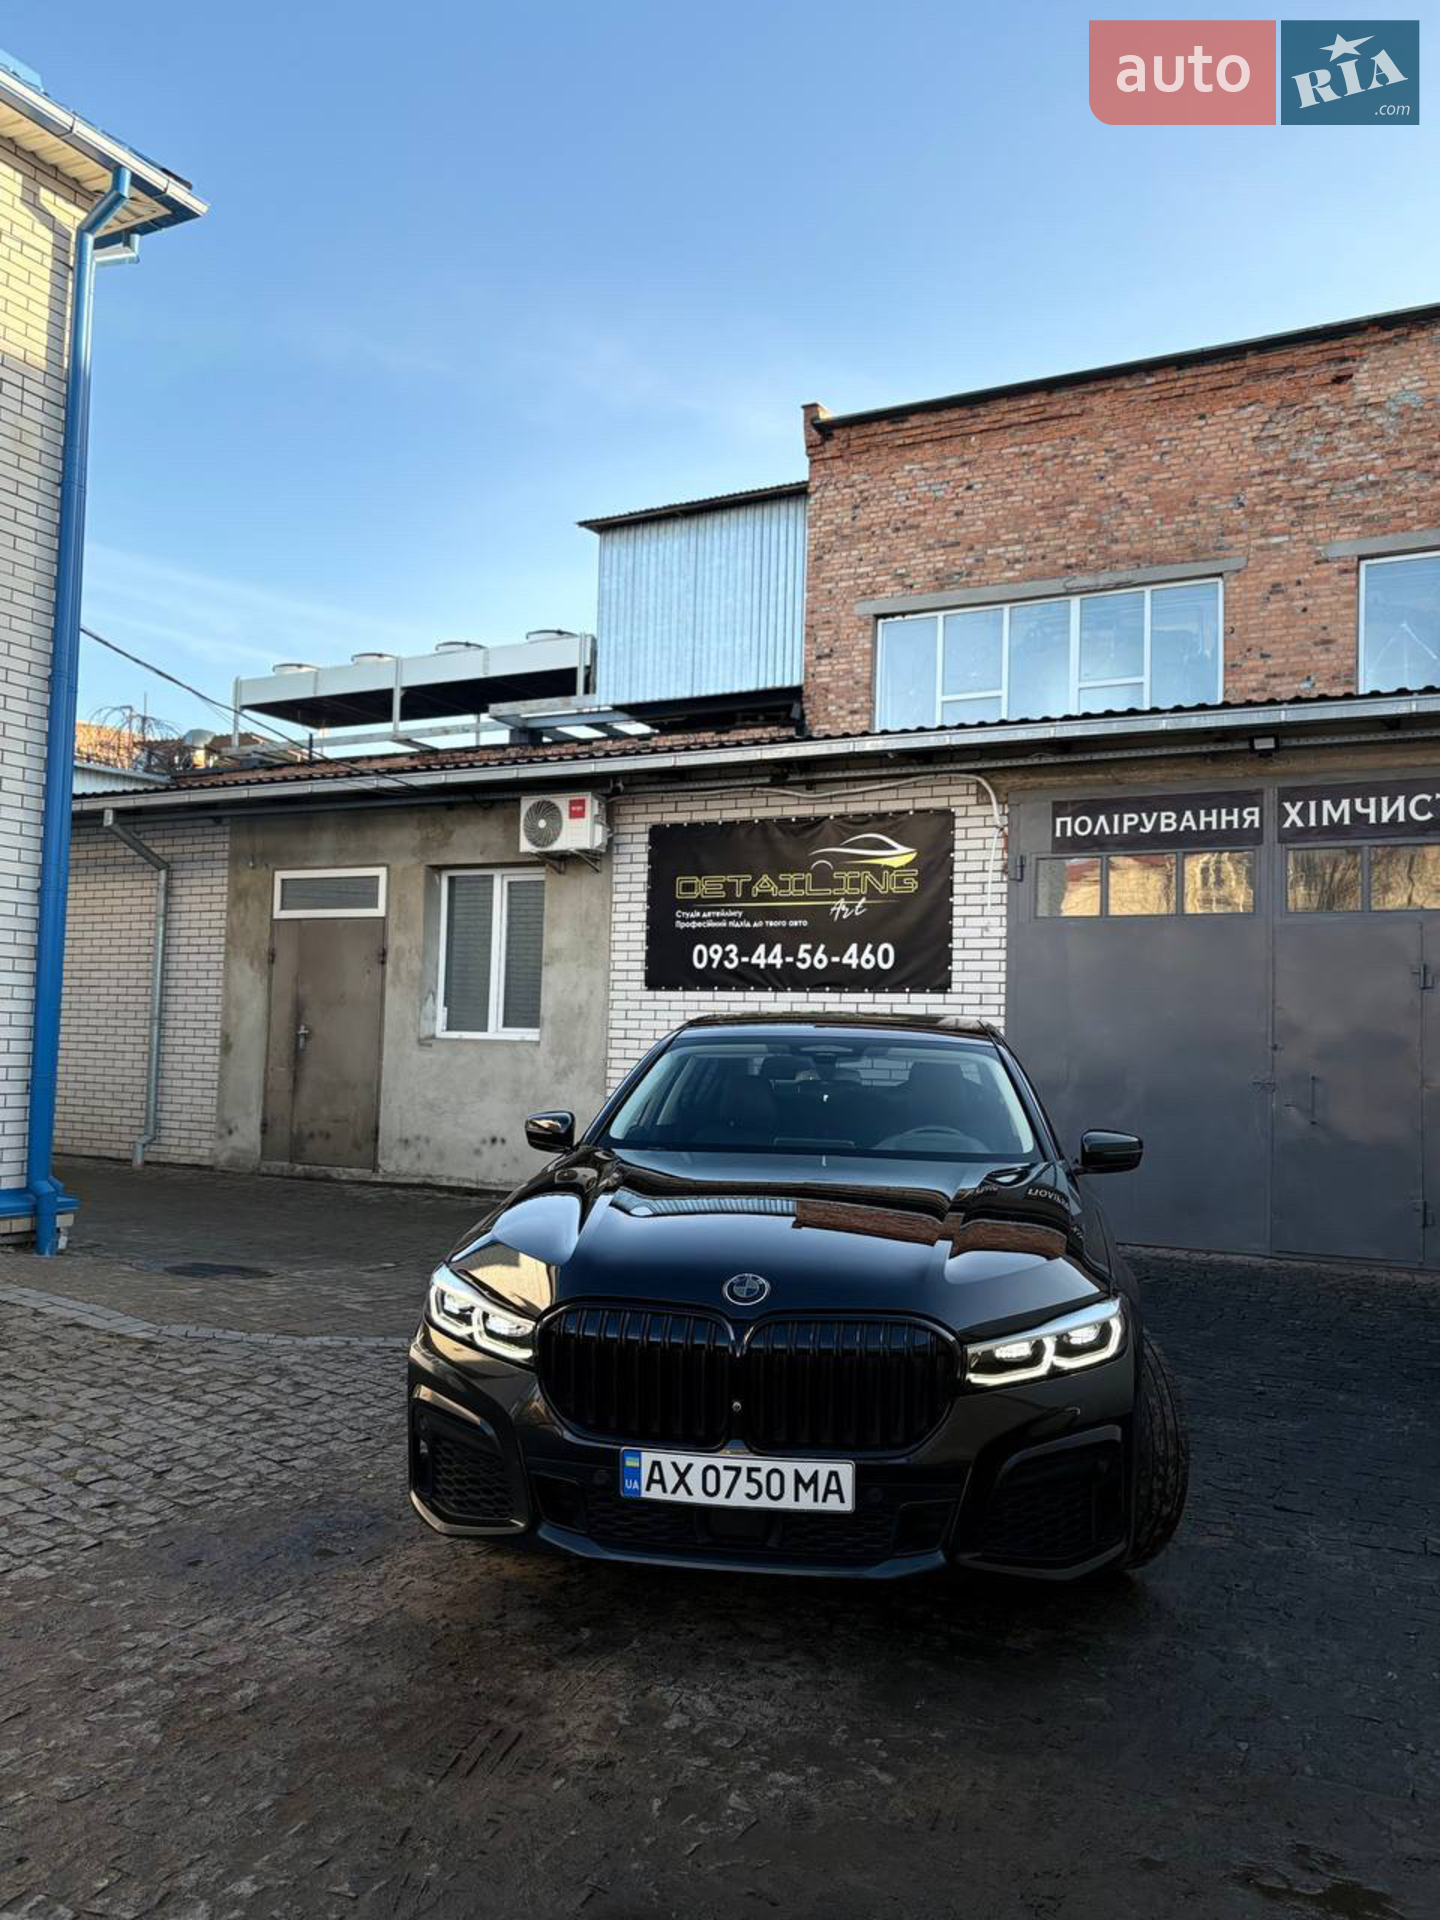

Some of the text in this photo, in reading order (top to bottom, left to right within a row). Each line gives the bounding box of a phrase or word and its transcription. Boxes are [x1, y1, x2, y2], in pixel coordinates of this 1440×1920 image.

[1054, 806, 1261, 838] ПОЛІРУВАННЯ
[1281, 792, 1440, 829] ХІМЧИС
[675, 869, 919, 899] DETAILING
[675, 909, 701, 919] Студія
[829, 896, 868, 922] Art
[752, 920, 763, 928] до
[765, 919, 787, 928] твого
[788, 919, 808, 927] авто
[692, 942, 896, 970] 093-44-56-460
[625, 1478, 640, 1490] UA
[645, 1460, 846, 1504] AX 0750 MA
